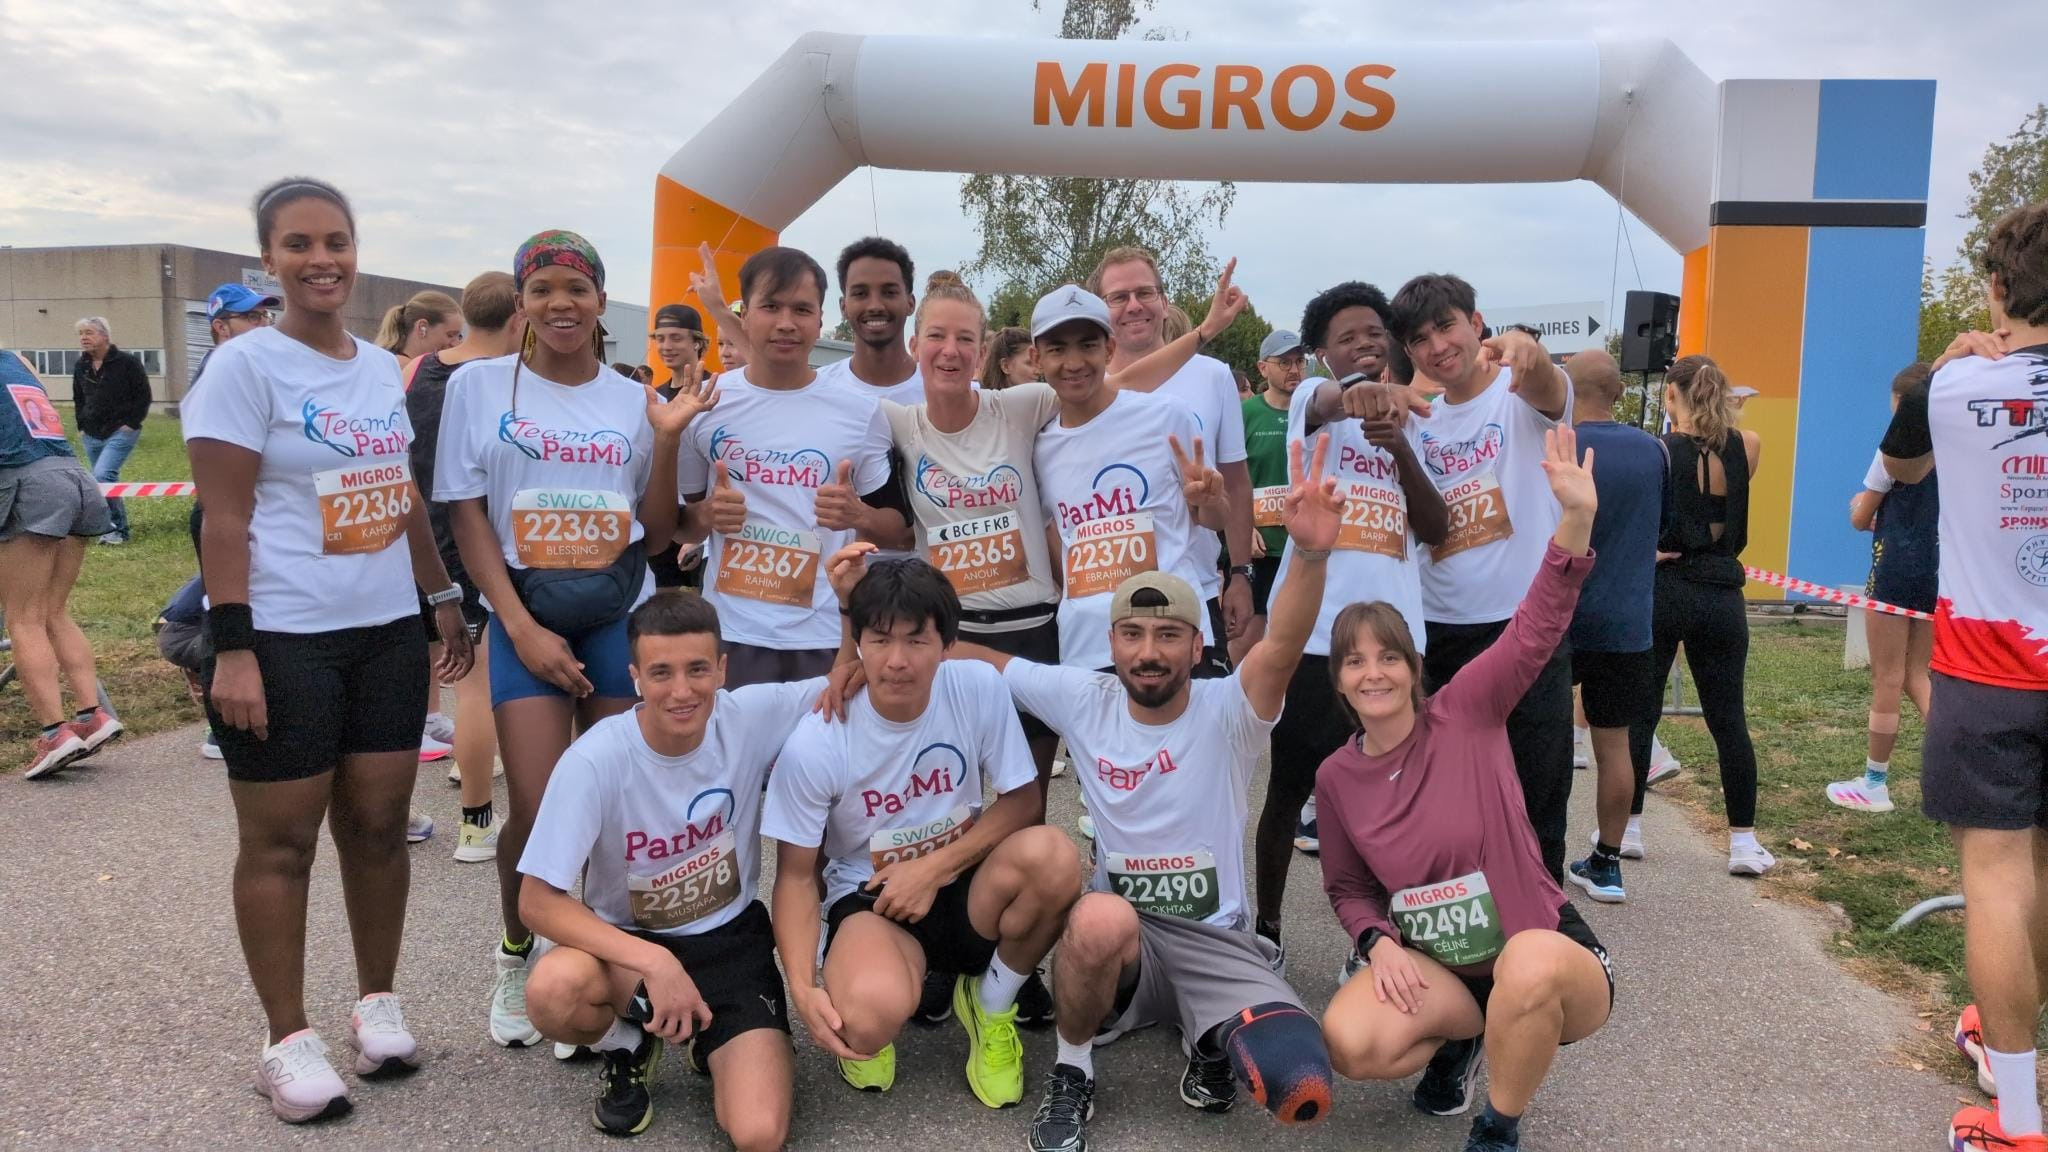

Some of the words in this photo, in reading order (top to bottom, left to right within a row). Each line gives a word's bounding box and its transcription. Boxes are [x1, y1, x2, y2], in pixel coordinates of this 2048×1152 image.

[1033, 62, 1397, 131] MIGROS
[1496, 320, 1580, 337] VAIRES
[318, 412, 389, 439] Team
[513, 420, 591, 443] Team
[542, 439, 622, 467] ParMi
[720, 439, 792, 465] Team
[1424, 440, 1478, 459] Team
[744, 460, 818, 489] ParMi
[1340, 445, 1399, 483] ParM
[340, 465, 403, 489] MIGROS
[925, 468, 989, 489] Team
[948, 483, 1018, 509] ParMi
[1350, 484, 1400, 505] MIGROS
[1444, 479, 1481, 502] GROS
[2000, 483, 2048, 503] Spor
[332, 485, 412, 528] 22366
[1057, 487, 1137, 529] ParMi
[1341, 499, 1404, 536] 22368
[1447, 494, 1497, 532] 372
[361, 522, 398, 538] KAHSAY
[524, 512, 620, 542] 22363
[953, 522, 980, 538] BCF
[1077, 518, 1136, 540] MIGROS
[1360, 529, 1389, 543] BARRY
[546, 544, 599, 556] BLESSING
[727, 542, 810, 579] 22367
[938, 534, 1016, 572] 22365
[1071, 535, 1148, 573] 22370
[745, 574, 781, 590] RAHIMI
[963, 567, 999, 582] ANOUK
[1086, 567, 1132, 583] EBRAHIMI
[625, 810, 724, 861] ParMi
[651, 847, 720, 889] MIGROS
[1124, 855, 1195, 871] MIGROS
[642, 860, 731, 911] 22578
[1119, 872, 1208, 902] 22490
[1403, 882, 1468, 907] MIGROS
[1139, 903, 1194, 915] OKHTAR
[1404, 898, 1489, 941] 22494
[1434, 938, 1470, 953] CÉLINE
